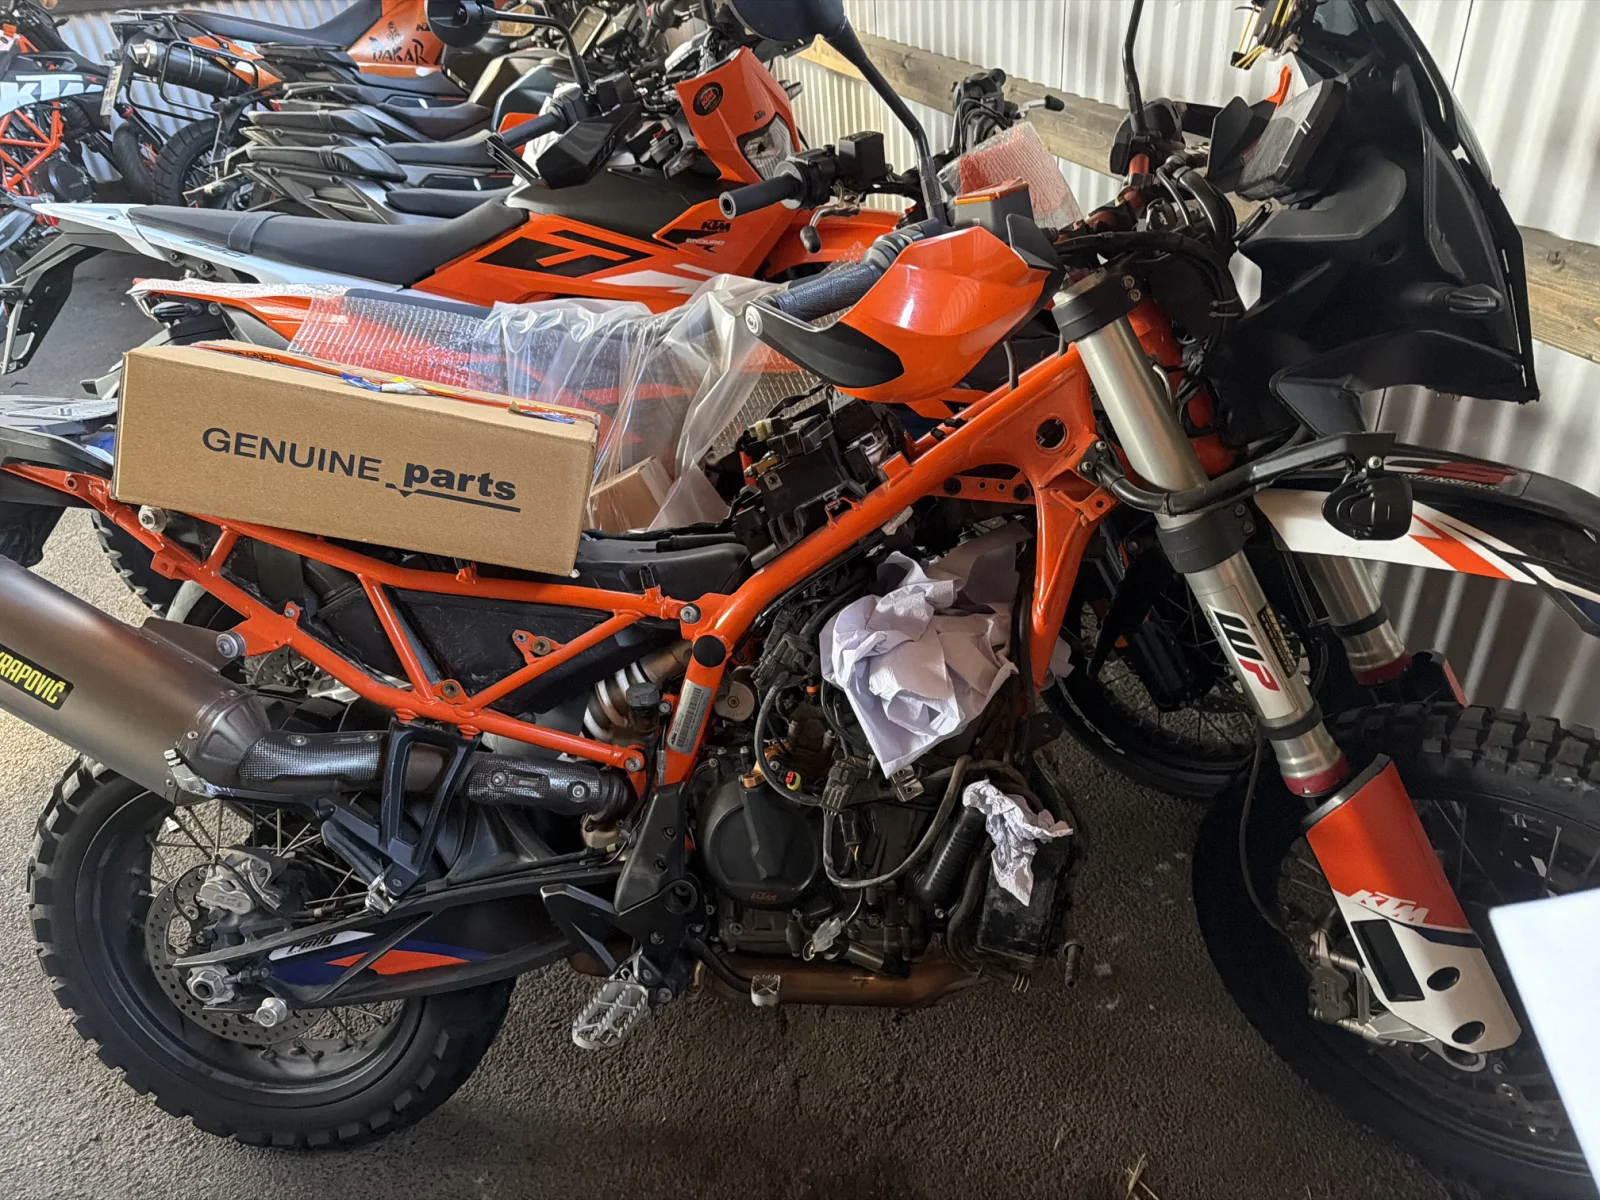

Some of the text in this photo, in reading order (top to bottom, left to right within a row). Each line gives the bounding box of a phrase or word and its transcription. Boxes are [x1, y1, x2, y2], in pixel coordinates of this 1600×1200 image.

[368, 36, 429, 65] DAKAR
[701, 219, 731, 232] KTM
[202, 427, 516, 501] GENUINE parts
[1213, 610, 1280, 691] WP
[1353, 889, 1430, 925] KTM
